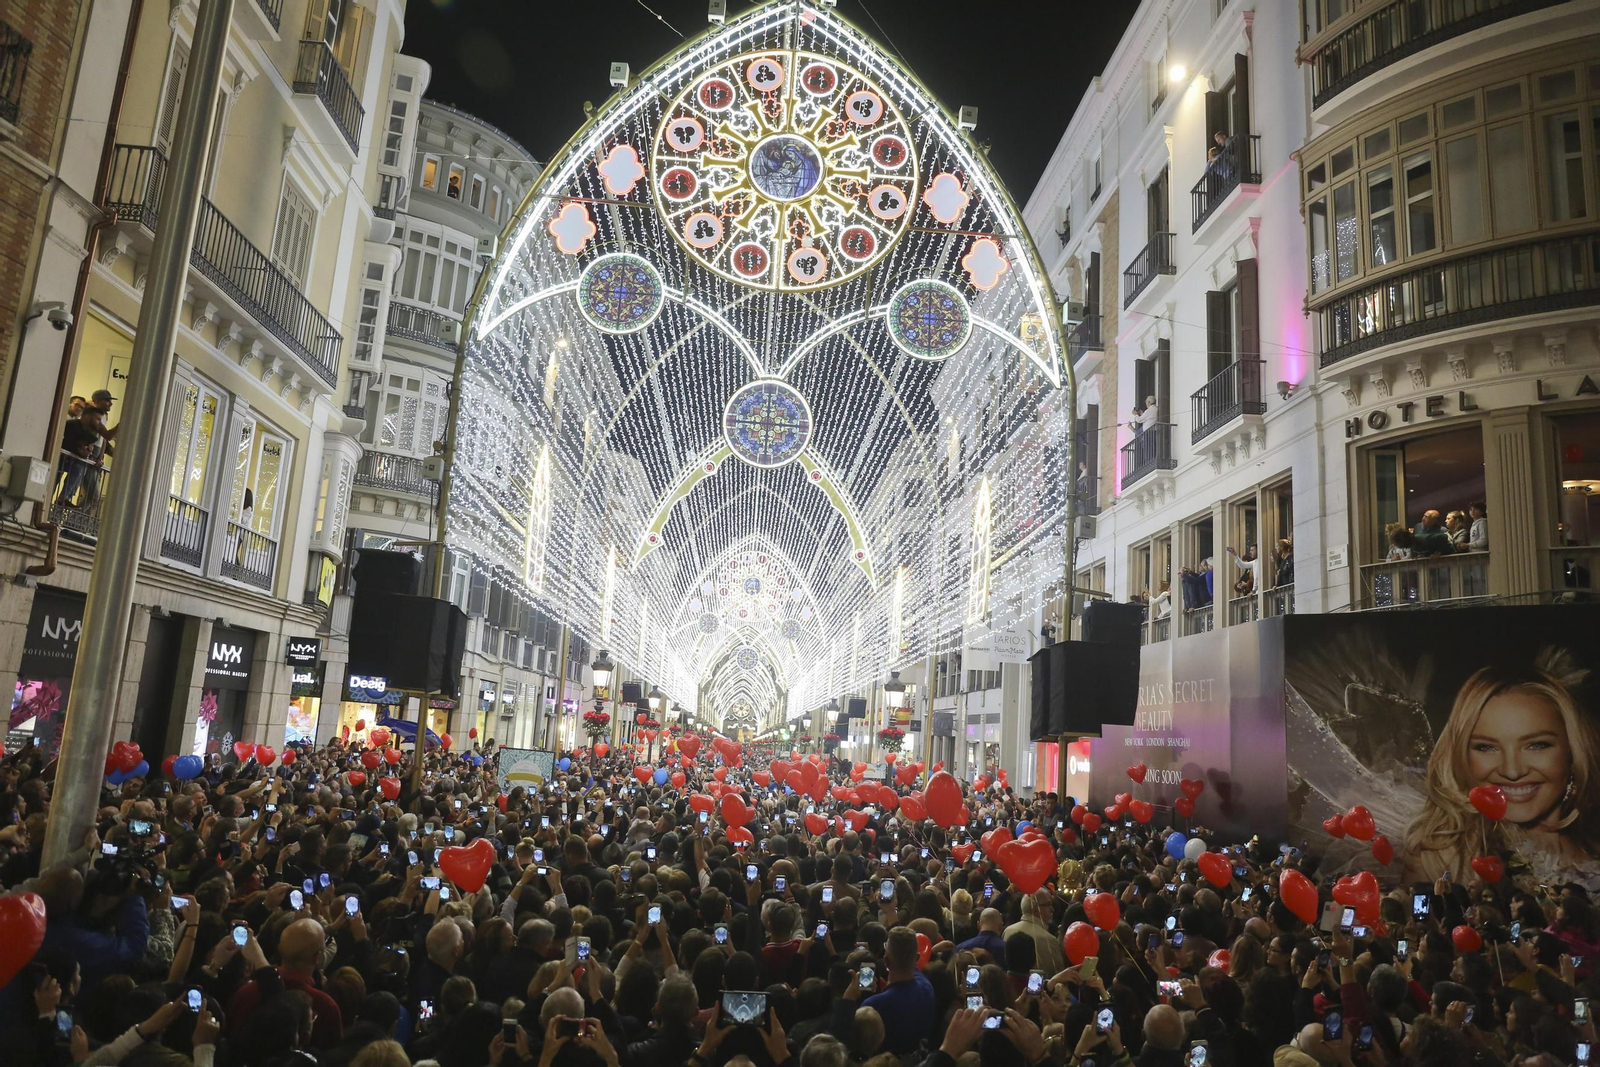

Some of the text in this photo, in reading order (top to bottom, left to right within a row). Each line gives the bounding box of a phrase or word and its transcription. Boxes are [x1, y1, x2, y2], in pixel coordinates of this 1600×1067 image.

[112, 368, 129, 380] En
[1344, 374, 1600, 438] HOTEL LA
[41, 615, 82, 642] NYX
[290, 643, 316, 653] NYX
[994, 635, 1026, 646] LARIOS
[212, 642, 243, 664] NYX
[1168, 678, 1215, 704] SECRET
[1136, 710, 1174, 732] BEAUTY
[1124, 737, 1191, 747] NEW YORK LONDON SHANGHAI
[1161, 769, 1182, 785] SOON
